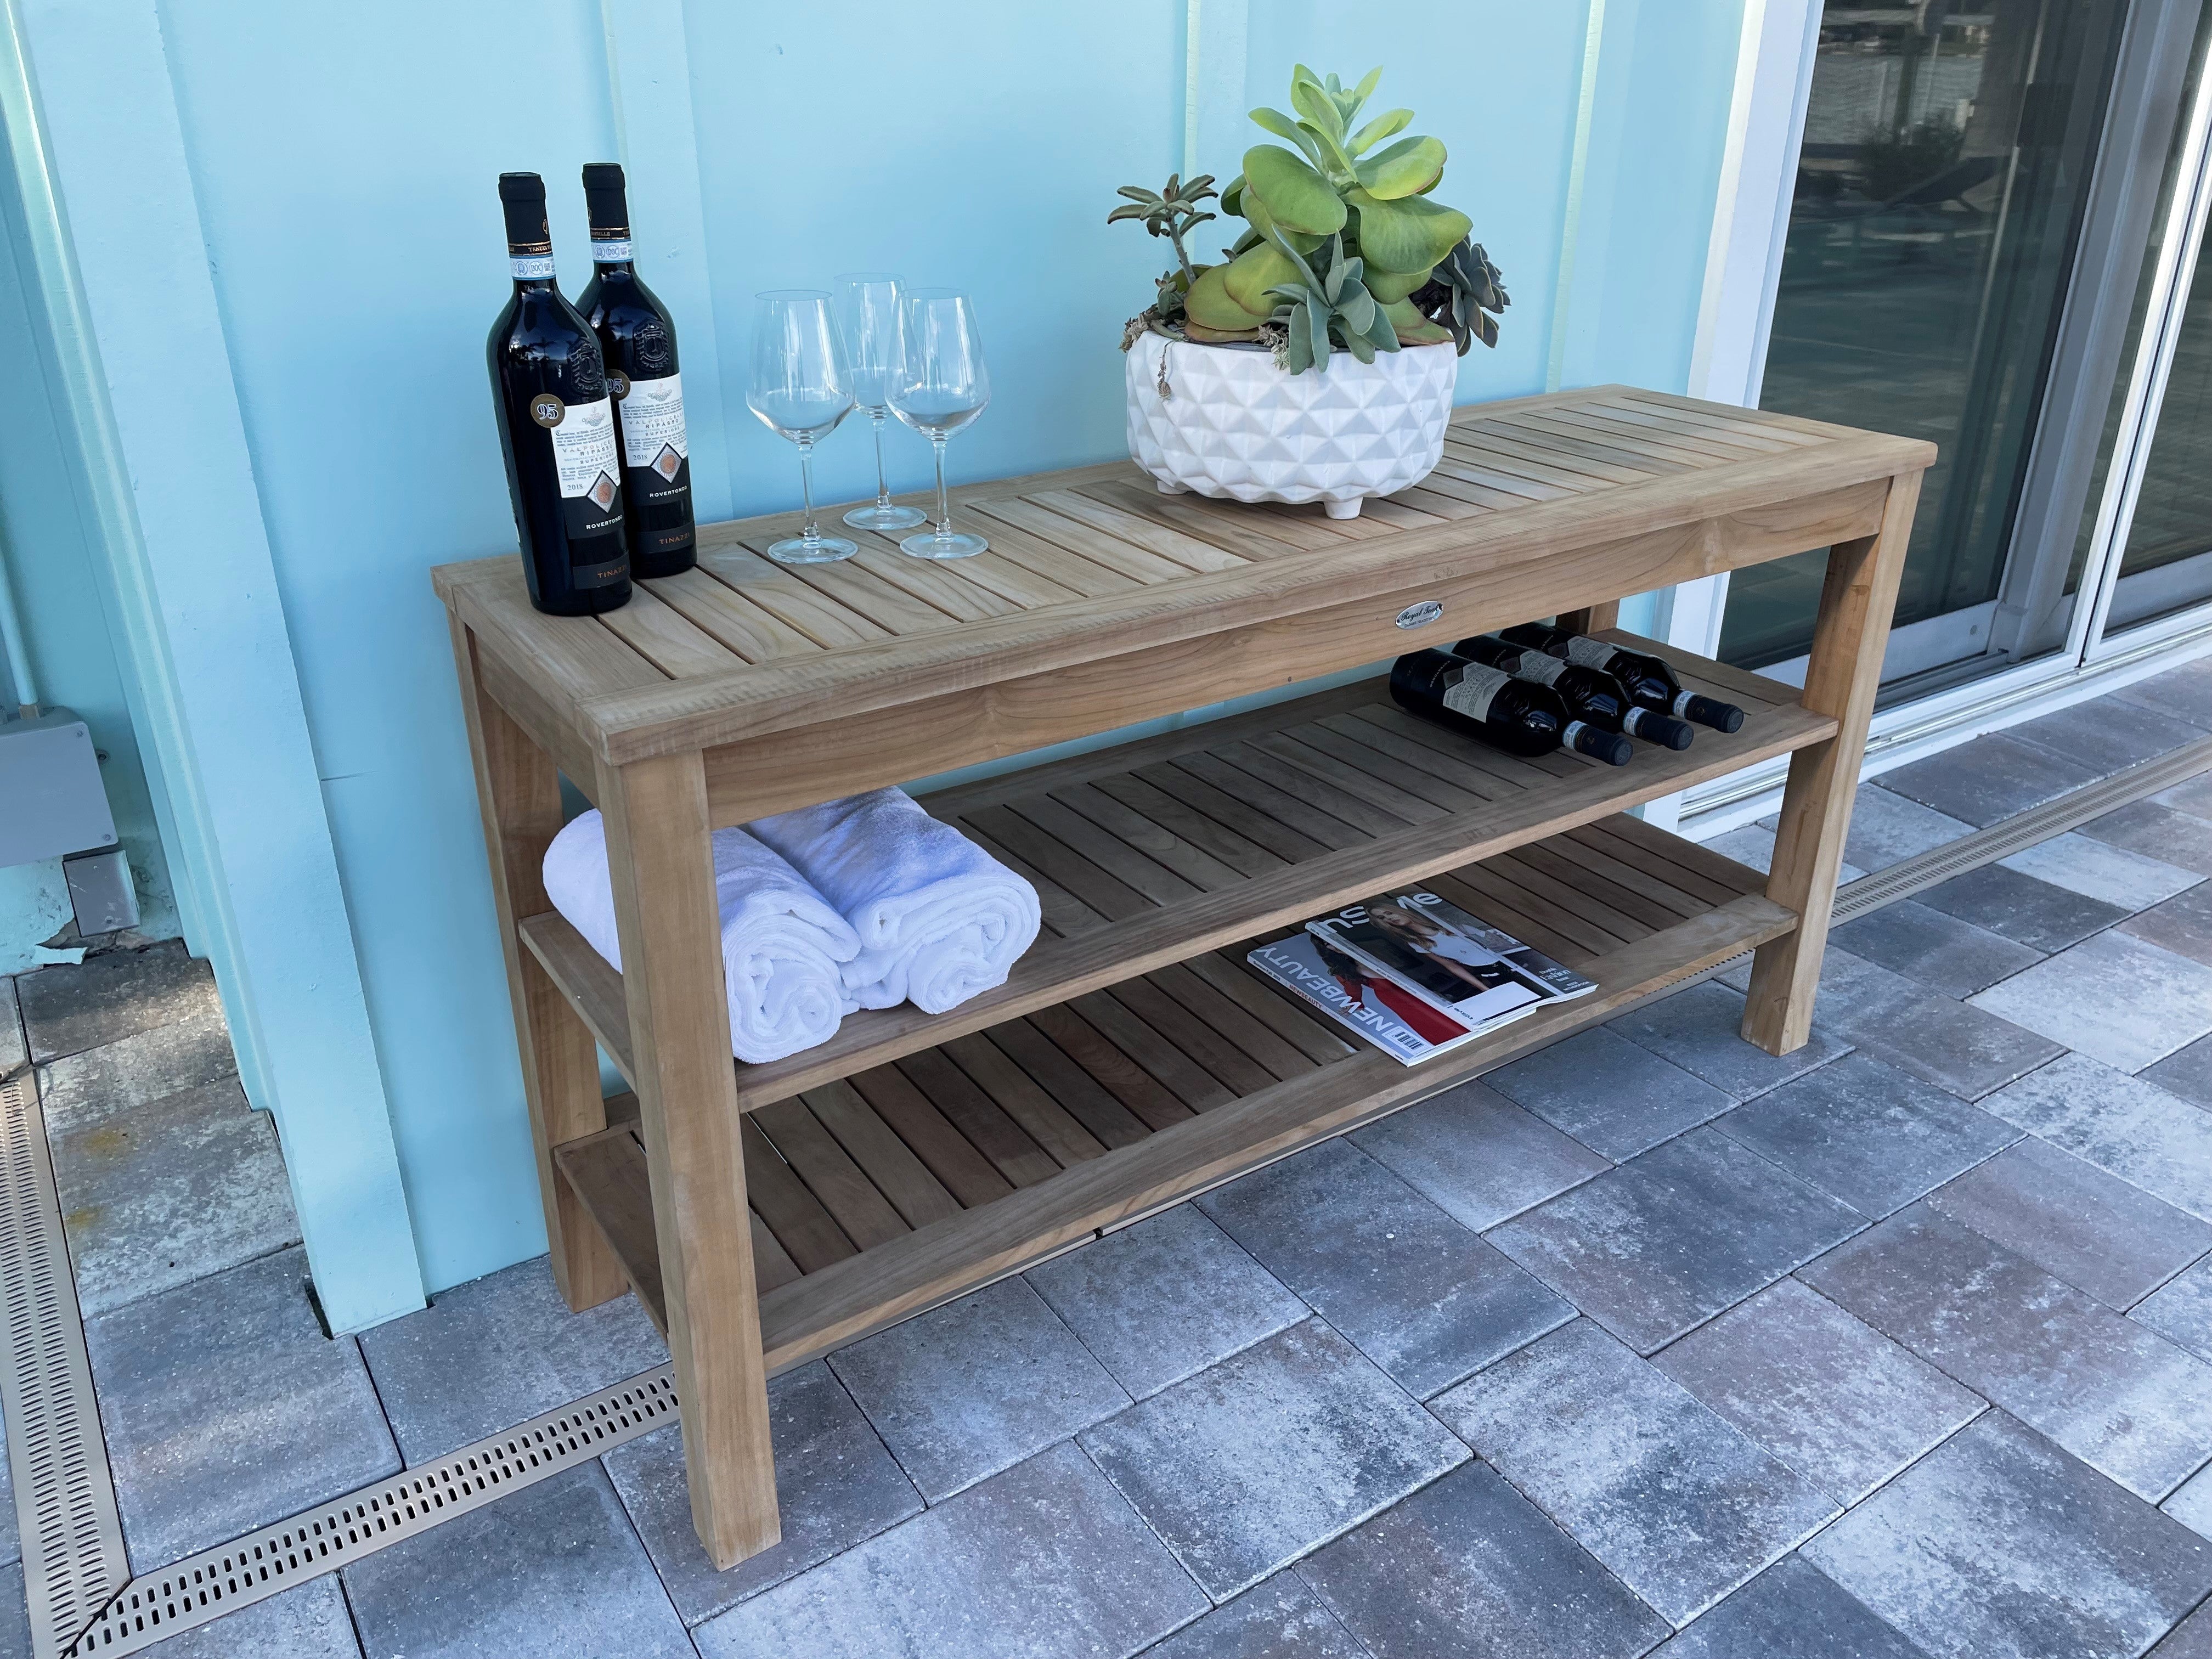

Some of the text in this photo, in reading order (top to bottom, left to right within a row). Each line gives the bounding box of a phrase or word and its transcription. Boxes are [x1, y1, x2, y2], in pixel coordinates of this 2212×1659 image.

[607, 378, 624, 393] 95
[537, 403, 558, 420] 95
[645, 419, 679, 428] RIPASSO
[580, 444, 612, 456] RIPASSO
[650, 485, 687, 498] ROVERTONDO
[586, 515, 623, 530] ROVERTONDO
[659, 533, 690, 545] TINAZZI
[1401, 608, 1424, 622] Royal
[1539, 969, 1572, 981] Fashion
[1255, 947, 1394, 1031] NEWBEAUTY
[1289, 985, 1322, 1008] NEWBEAUTY
